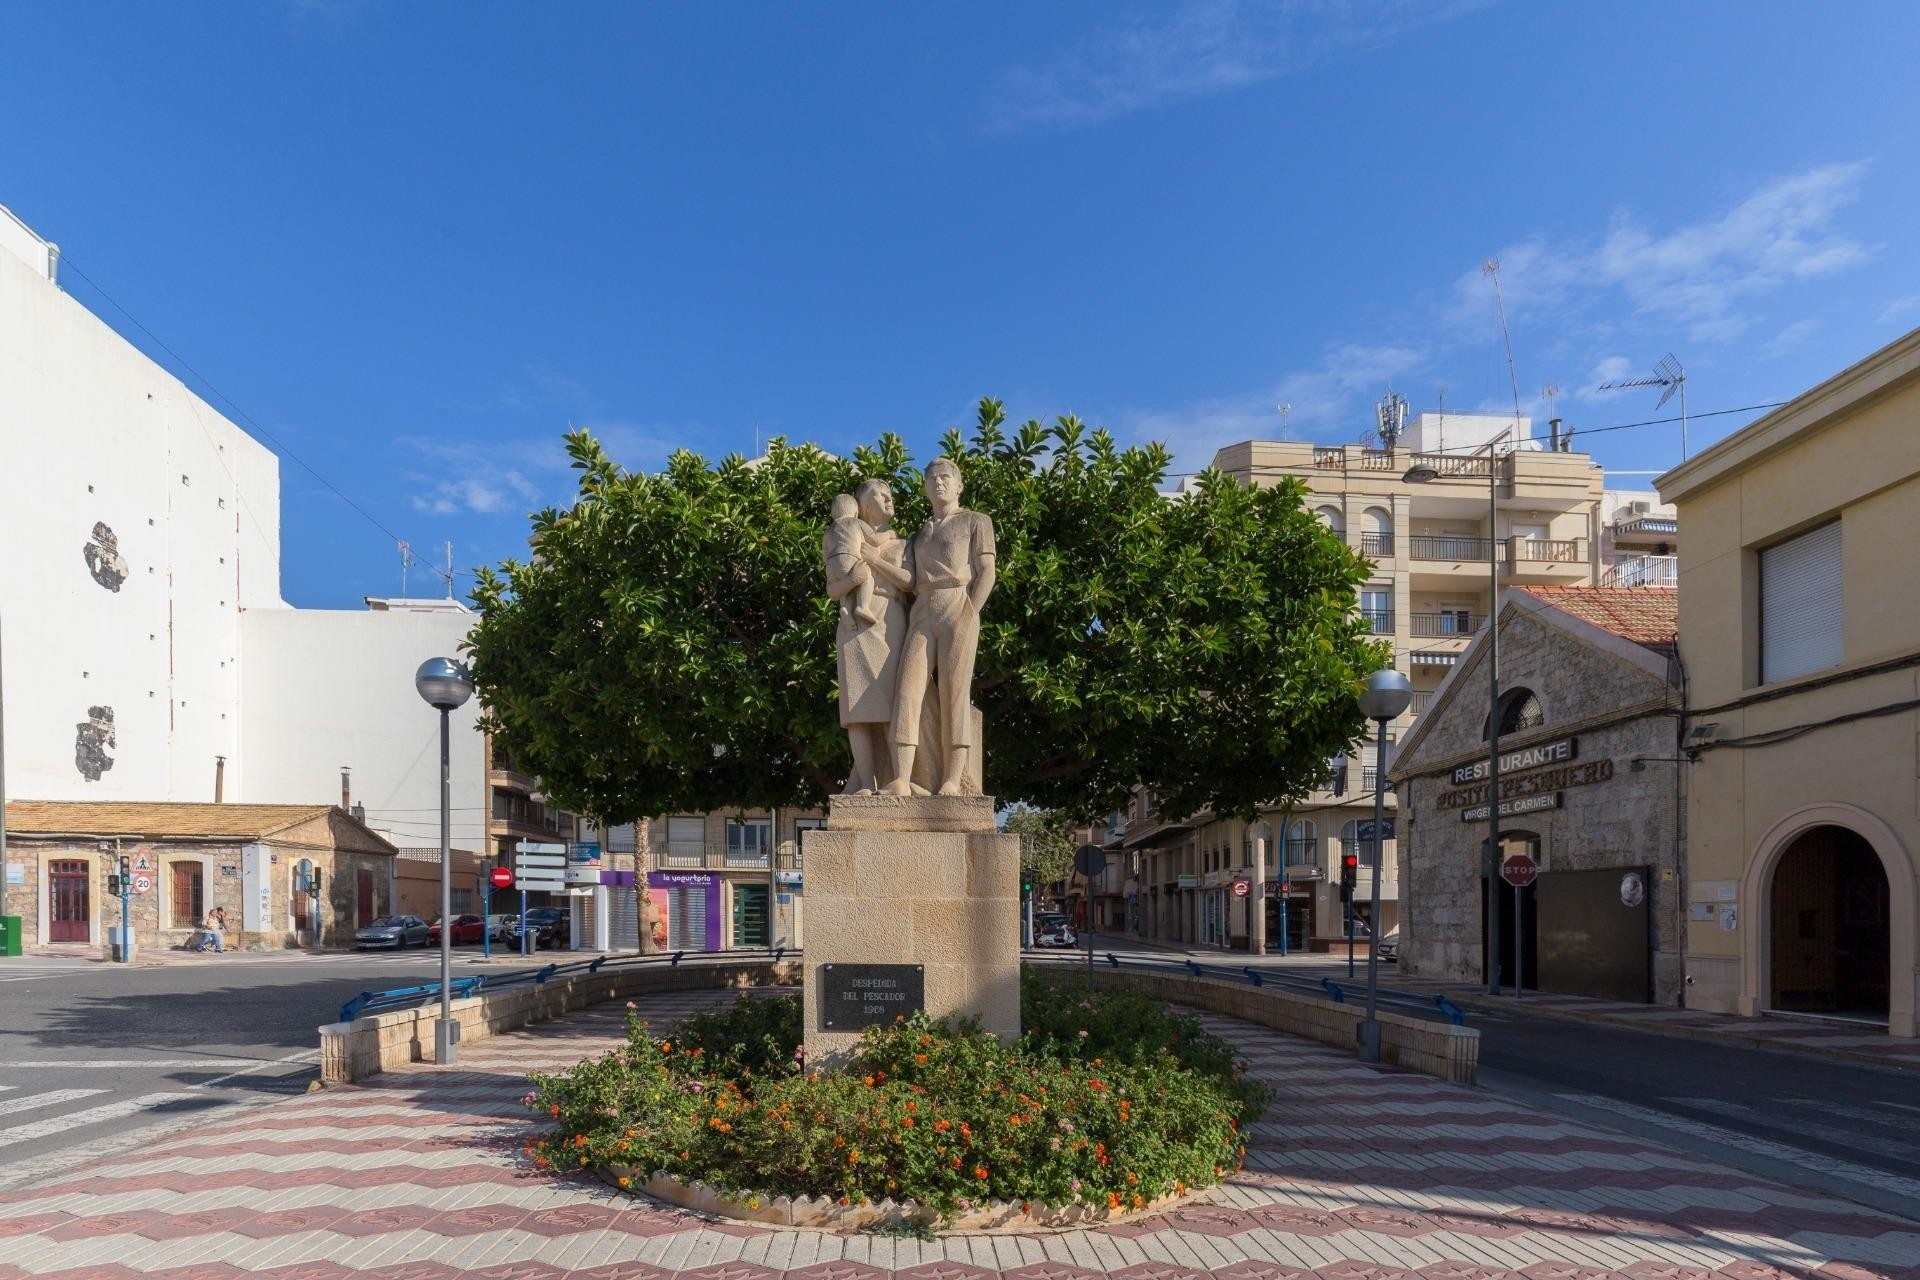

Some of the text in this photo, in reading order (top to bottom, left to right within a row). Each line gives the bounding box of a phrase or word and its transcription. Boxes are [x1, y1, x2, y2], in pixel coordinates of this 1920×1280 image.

[1455, 742, 1568, 783] RESTURANTE
[1514, 795, 1554, 812] CARMEN
[1504, 866, 1536, 874] STOP
[663, 873, 670, 881] la
[138, 880, 149, 888] 20
[851, 978, 897, 988] DESPEDIDA
[842, 992, 906, 1001] DEL PESCADOR
